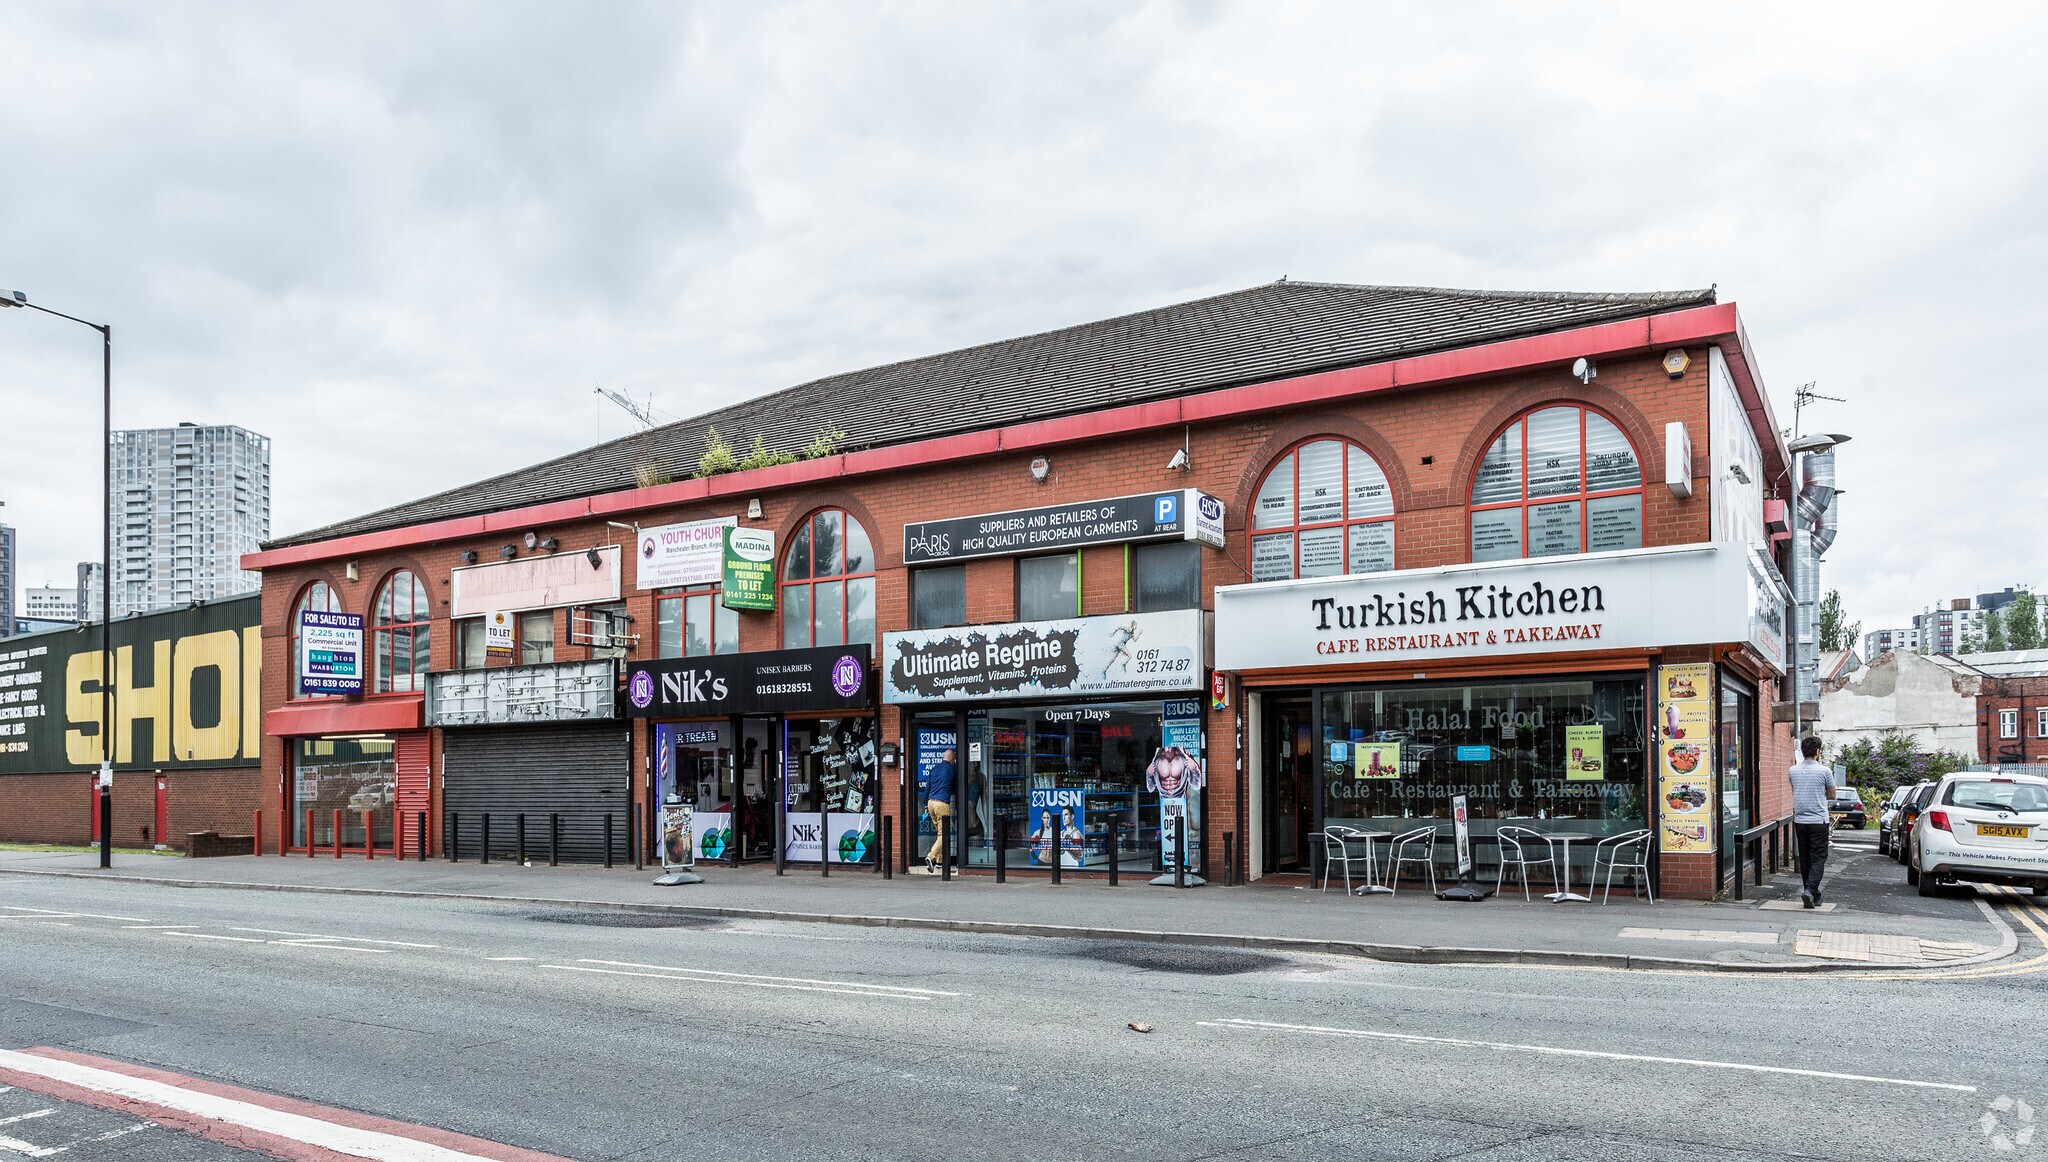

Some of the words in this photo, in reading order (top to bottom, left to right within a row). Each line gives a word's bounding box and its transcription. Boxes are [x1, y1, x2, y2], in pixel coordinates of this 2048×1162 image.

[1595, 451, 1630, 461] SATURDAY
[1484, 462, 1511, 471] MONDAY
[1546, 459, 1560, 470] HSK
[1491, 468, 1513, 476] FRIDAY
[1529, 475, 1559, 486] ACCOUNTANCY
[1558, 473, 1578, 483] SERVICES
[1315, 488, 1327, 497] HSK
[1354, 484, 1385, 493] ENTRANCE
[1366, 490, 1382, 498] BACK
[1262, 496, 1286, 504] PARKING
[1301, 503, 1325, 511] ACCOUNTANCY
[1325, 501, 1342, 509] SERVICES
[1159, 499, 1173, 521] P
[1201, 497, 1218, 519] HSK
[979, 518, 1025, 534] SUPPLIERS
[1028, 515, 1047, 529] AND
[1050, 508, 1098, 526] RETAILERS
[1100, 506, 1116, 519] OF
[1162, 523, 1177, 532] REAR
[660, 529, 692, 546] YOUTH
[910, 526, 951, 555] PARIS
[962, 537, 984, 551] HIGH
[986, 532, 1028, 550] QUALITY
[1029, 526, 1082, 545] EUROPEAN
[1084, 519, 1139, 540] GARMENTS
[666, 545, 691, 554] Manchester
[735, 541, 771, 552] MADINA
[727, 560, 753, 570] GROUND
[753, 562, 771, 572] FLOOR
[735, 570, 765, 581] PREMISES
[737, 579, 748, 591] TO
[749, 580, 762, 591] LET
[726, 590, 742, 599] 0161
[743, 592, 757, 600] 225
[757, 593, 773, 601] 1234
[1311, 590, 1447, 631] Turkish
[1455, 581, 1605, 621] Kitchen
[305, 613, 319, 624] FOR
[320, 614, 347, 626] SALE/TO
[349, 617, 360, 627] LET
[310, 629, 333, 637] 2,225
[335, 631, 345, 639] sq
[348, 631, 355, 639] ft
[488, 627, 498, 637] TO
[499, 628, 511, 637] LET
[308, 637, 343, 646] Commercial
[1316, 639, 1360, 655] CAFE
[1365, 631, 1480, 652] RESTAURANT
[1486, 629, 1498, 645] &
[1504, 623, 1603, 643] TAKEAWAY
[311, 652, 354, 662] haughton
[902, 649, 980, 678] Ultimate
[985, 639, 1063, 669] Regime
[1136, 649, 1160, 661] 0161
[311, 664, 354, 672] WARBURTON
[756, 665, 781, 675] UNISEX
[782, 663, 812, 673] BARBERS
[1136, 662, 1158, 674] 312
[1160, 660, 1174, 672] 74
[1175, 658, 1191, 671] 87
[933, 673, 985, 688] Supplement,
[988, 669, 1028, 682] Vitamins,
[1030, 663, 1067, 677] Proteins
[1215, 676, 1224, 686] JUST
[304, 678, 321, 687] 0161
[322, 679, 338, 687] 839
[338, 680, 361, 689] 0080
[661, 669, 729, 704] Nik's
[756, 682, 812, 695] 01618328551
[1080, 675, 1193, 691] www.ultimateregime.co.uk
[1216, 685, 1224, 694] EAT
[1045, 709, 1074, 723] Open
[1075, 711, 1082, 722] 7
[1084, 708, 1111, 722] Days
[1405, 707, 1472, 731] Halal
[1481, 705, 1545, 729] Food
[995, 730, 1025, 743] SALE
[1101, 724, 1133, 738] SALE
[930, 732, 957, 745] USN
[1330, 780, 1371, 799] Cafe
[1390, 780, 1501, 799] Restaurant
[1508, 778, 1524, 799] &
[1532, 778, 1636, 805] Takeaway
[787, 793, 799, 805] £7
[1046, 790, 1082, 807] USN
[1164, 804, 1183, 817] NOW
[792, 823, 822, 842] Nik'
[1983, 826, 2003, 836] SG15
[2005, 827, 2023, 837] AVX
[1962, 852, 1985, 860] Vehicle
[2007, 855, 2036, 864] Frequent
